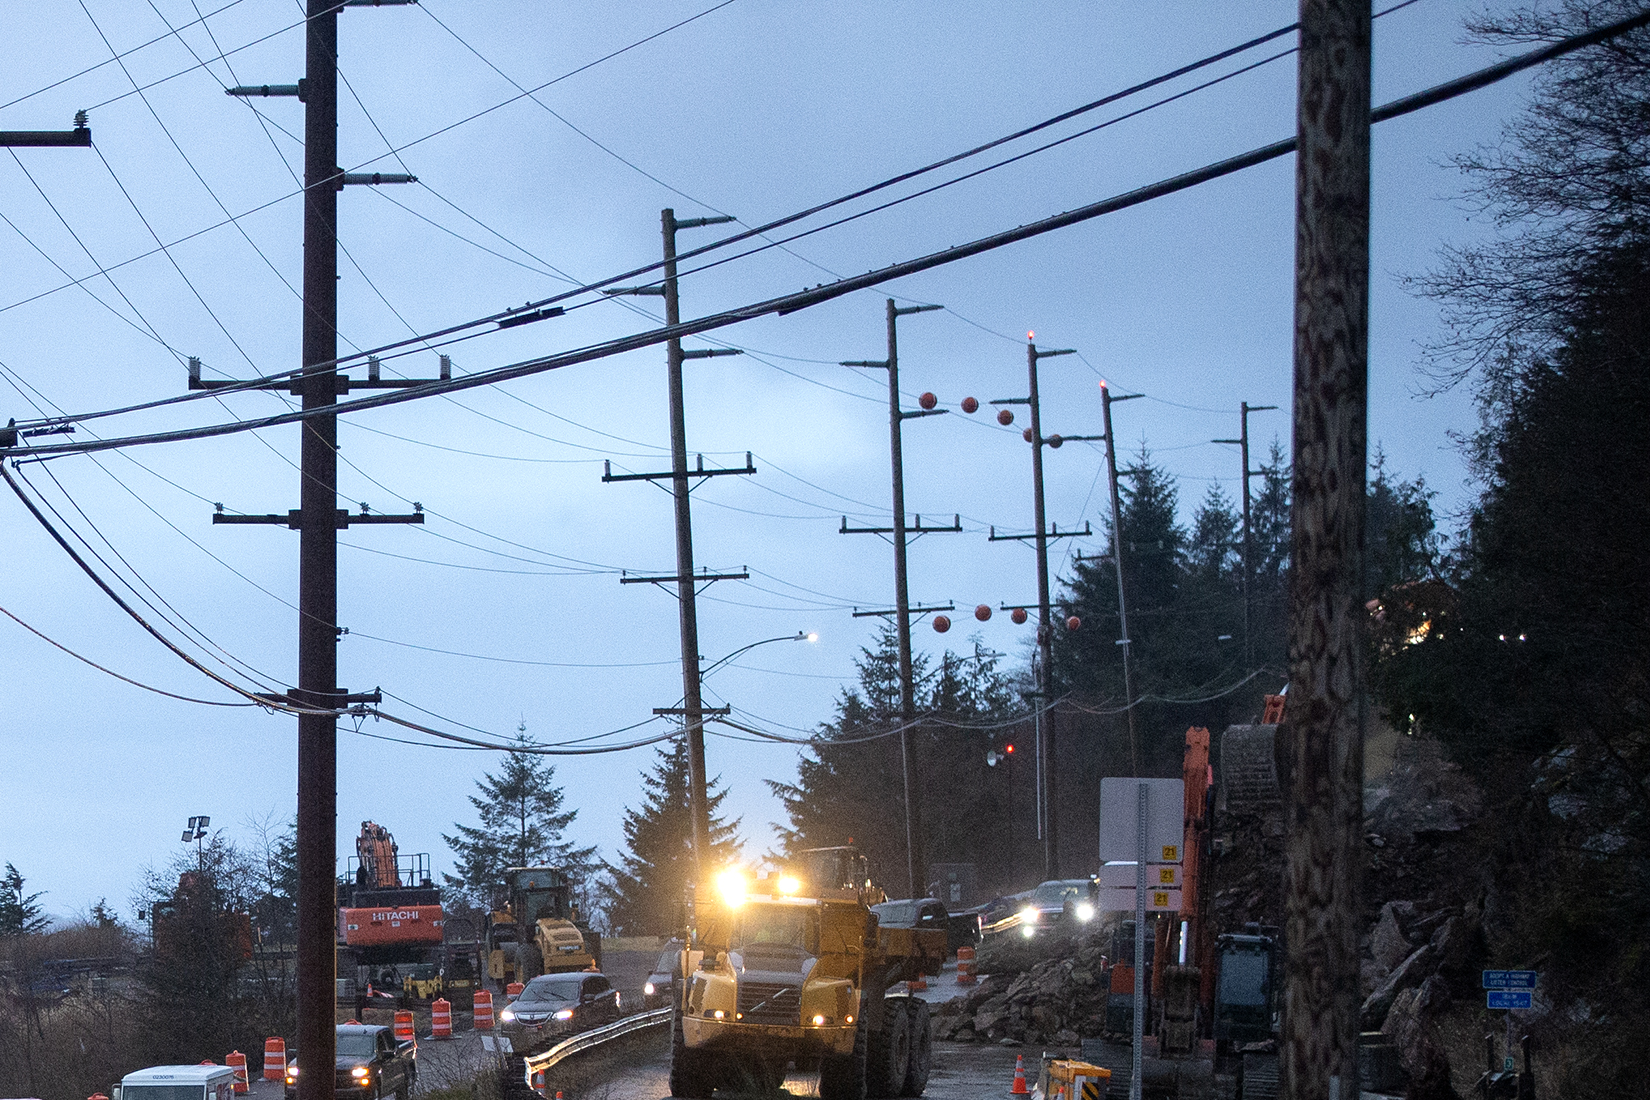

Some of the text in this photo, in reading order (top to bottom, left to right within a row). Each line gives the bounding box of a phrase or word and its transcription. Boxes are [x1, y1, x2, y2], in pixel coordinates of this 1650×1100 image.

[1164, 847, 1175, 857] 21
[1162, 870, 1173, 879] 21
[372, 910, 419, 921] HITACHI
